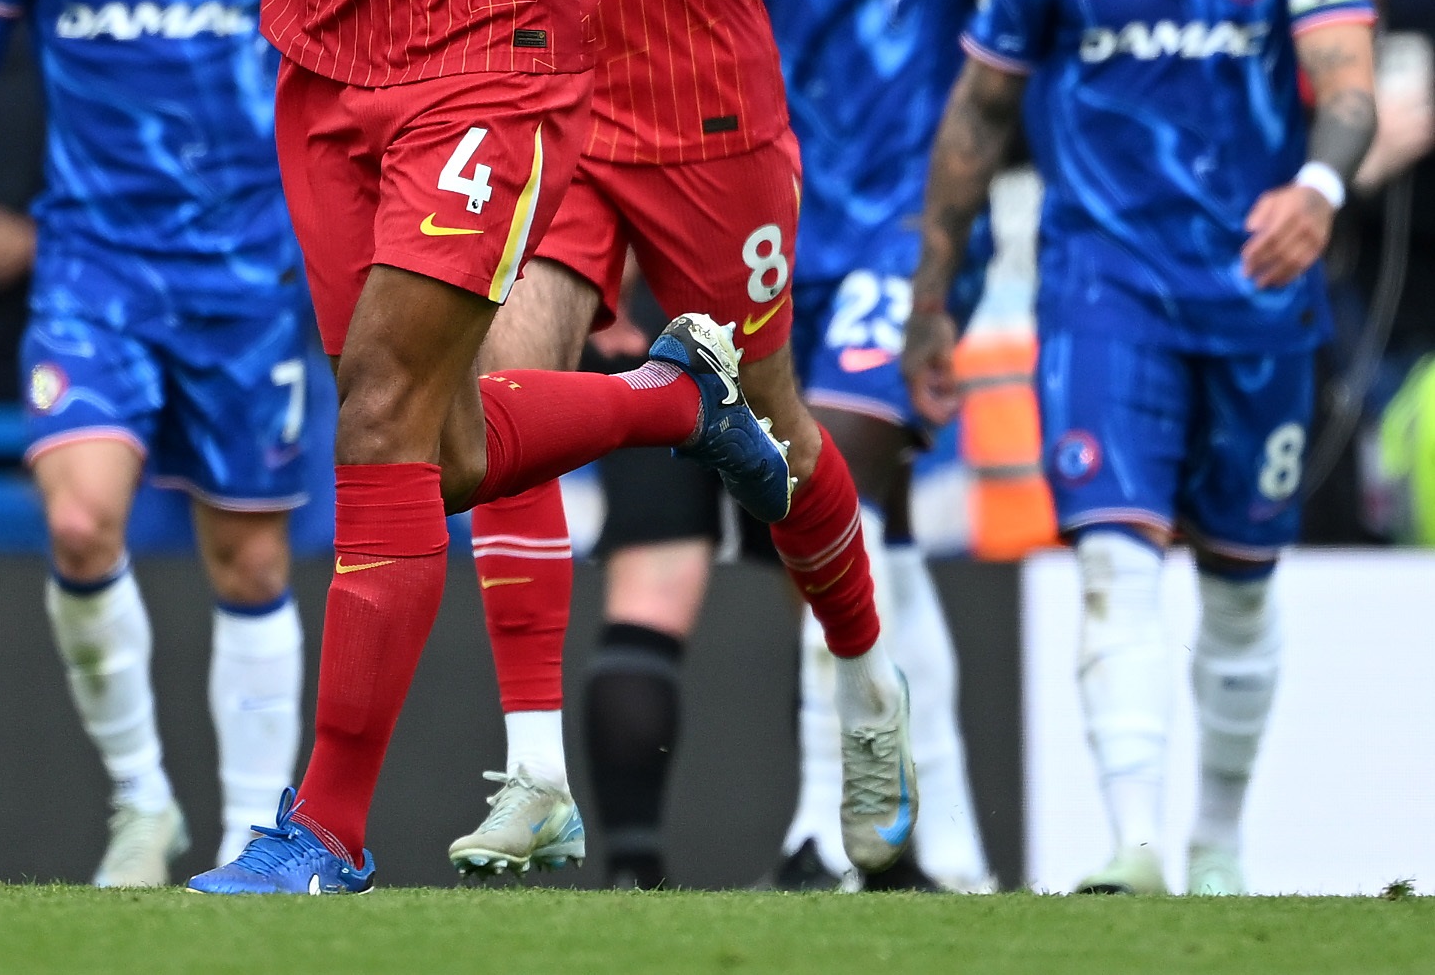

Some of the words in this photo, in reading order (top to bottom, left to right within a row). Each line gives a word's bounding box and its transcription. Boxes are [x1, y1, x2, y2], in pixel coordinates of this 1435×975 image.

[438, 127, 493, 214] 4
[742, 224, 789, 303] 8
[272, 360, 306, 443] 7
[1257, 422, 1306, 501] 8
